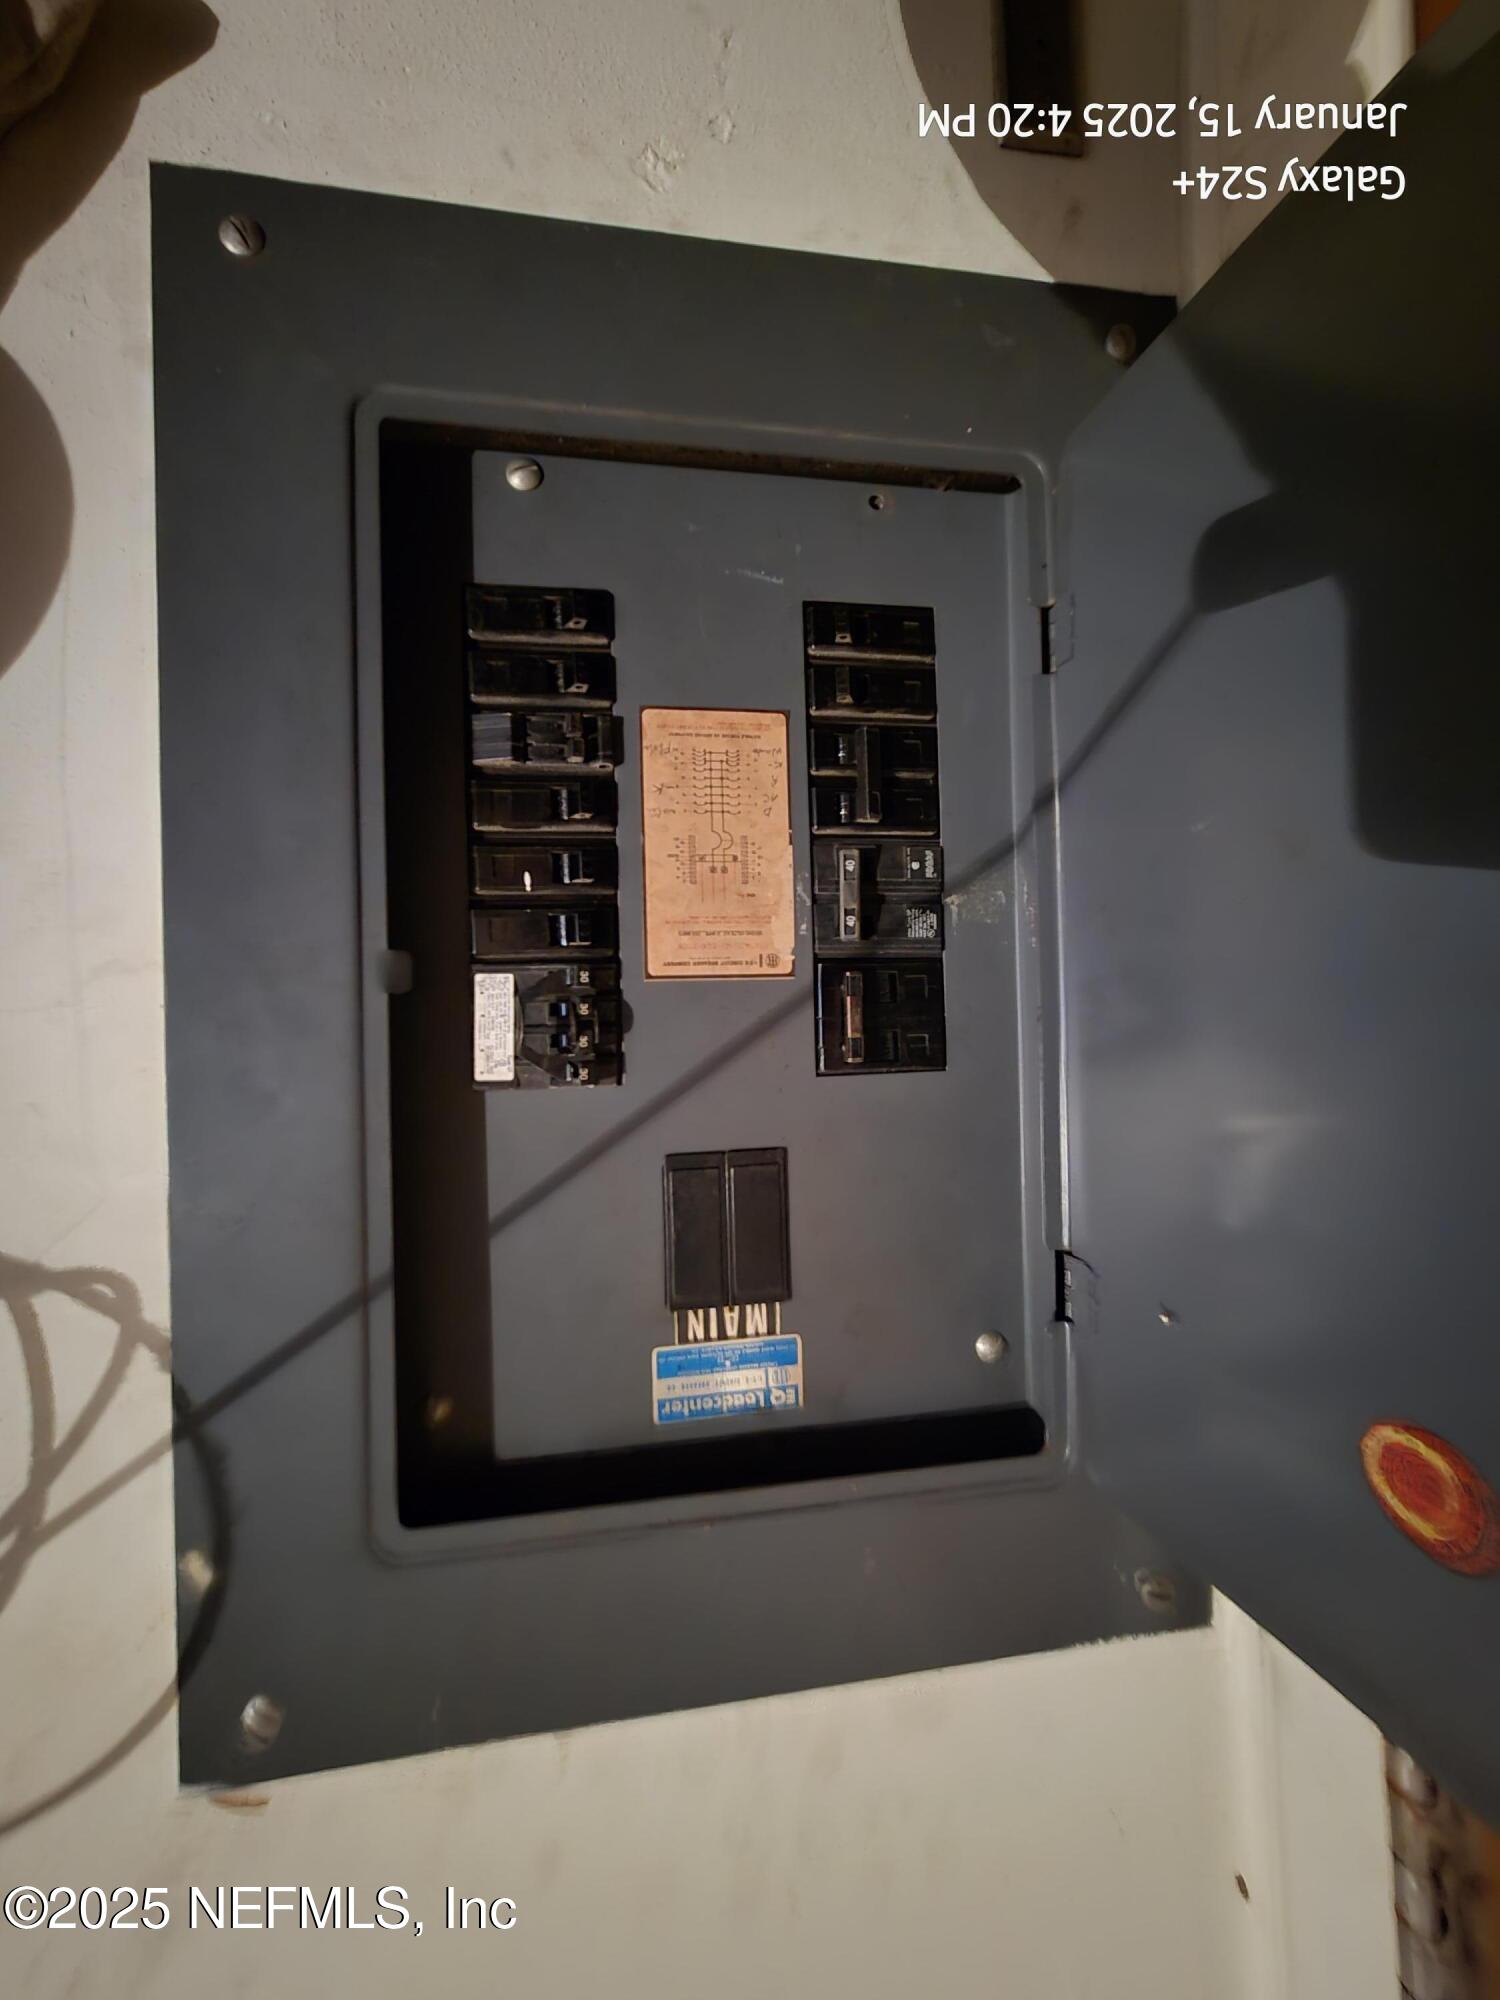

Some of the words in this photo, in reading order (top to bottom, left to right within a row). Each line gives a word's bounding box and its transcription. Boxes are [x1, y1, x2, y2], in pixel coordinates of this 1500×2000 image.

[845, 860, 855, 872] 40
[846, 915, 856, 927] 40
[688, 1303, 767, 1341] MAIN
[662, 1391, 765, 1417] Loadcenter
[770, 1387, 796, 1405] EQ
